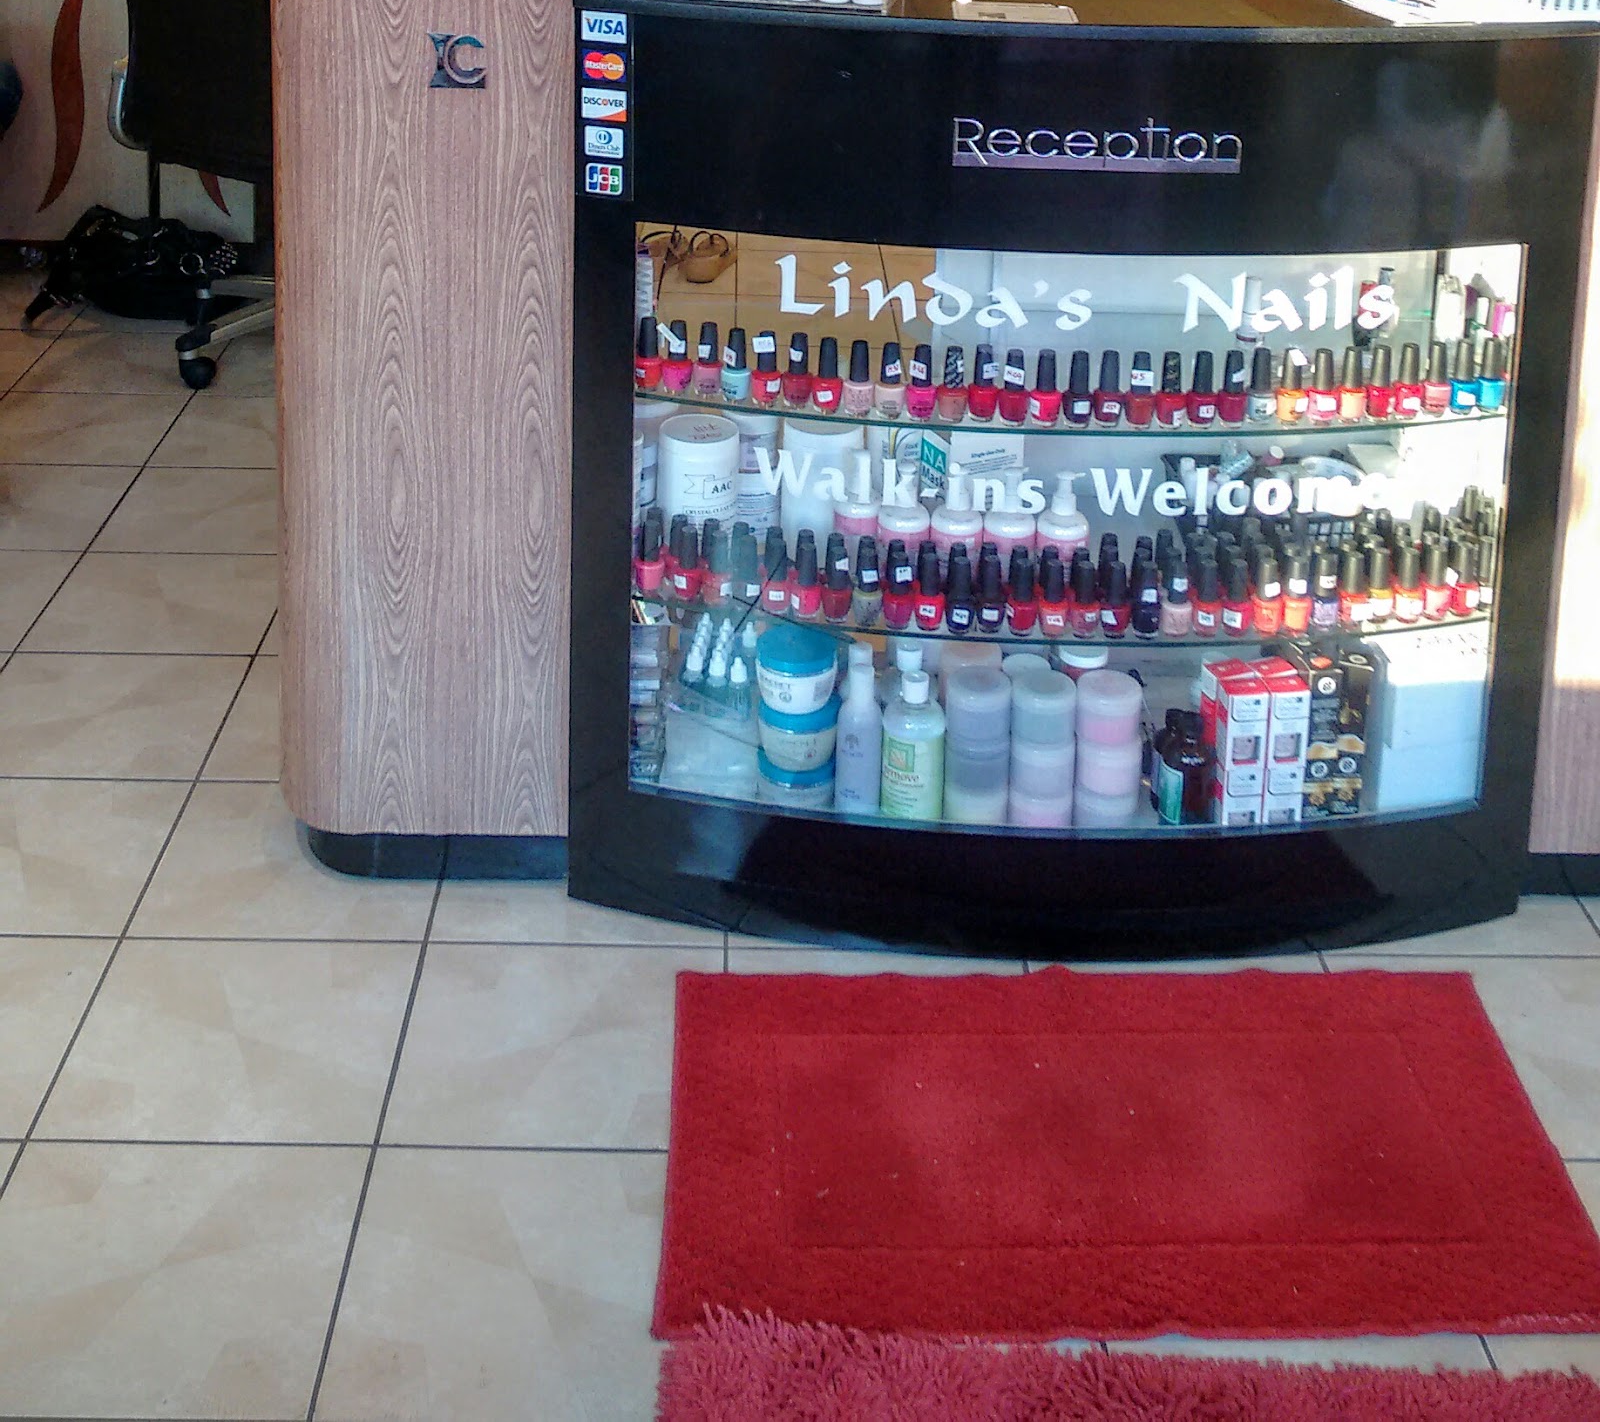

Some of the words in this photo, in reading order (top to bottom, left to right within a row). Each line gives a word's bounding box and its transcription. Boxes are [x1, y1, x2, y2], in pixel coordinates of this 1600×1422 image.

[585, 17, 625, 36] VISA
[583, 96, 624, 108] DISCOVER
[952, 116, 1243, 168] Reception
[588, 172, 620, 186] JCB
[774, 254, 1092, 330] Linda's
[1173, 266, 1398, 333] Nails
[753, 447, 1046, 515] Walk-ins
[1089, 467, 1398, 518] Welcome
